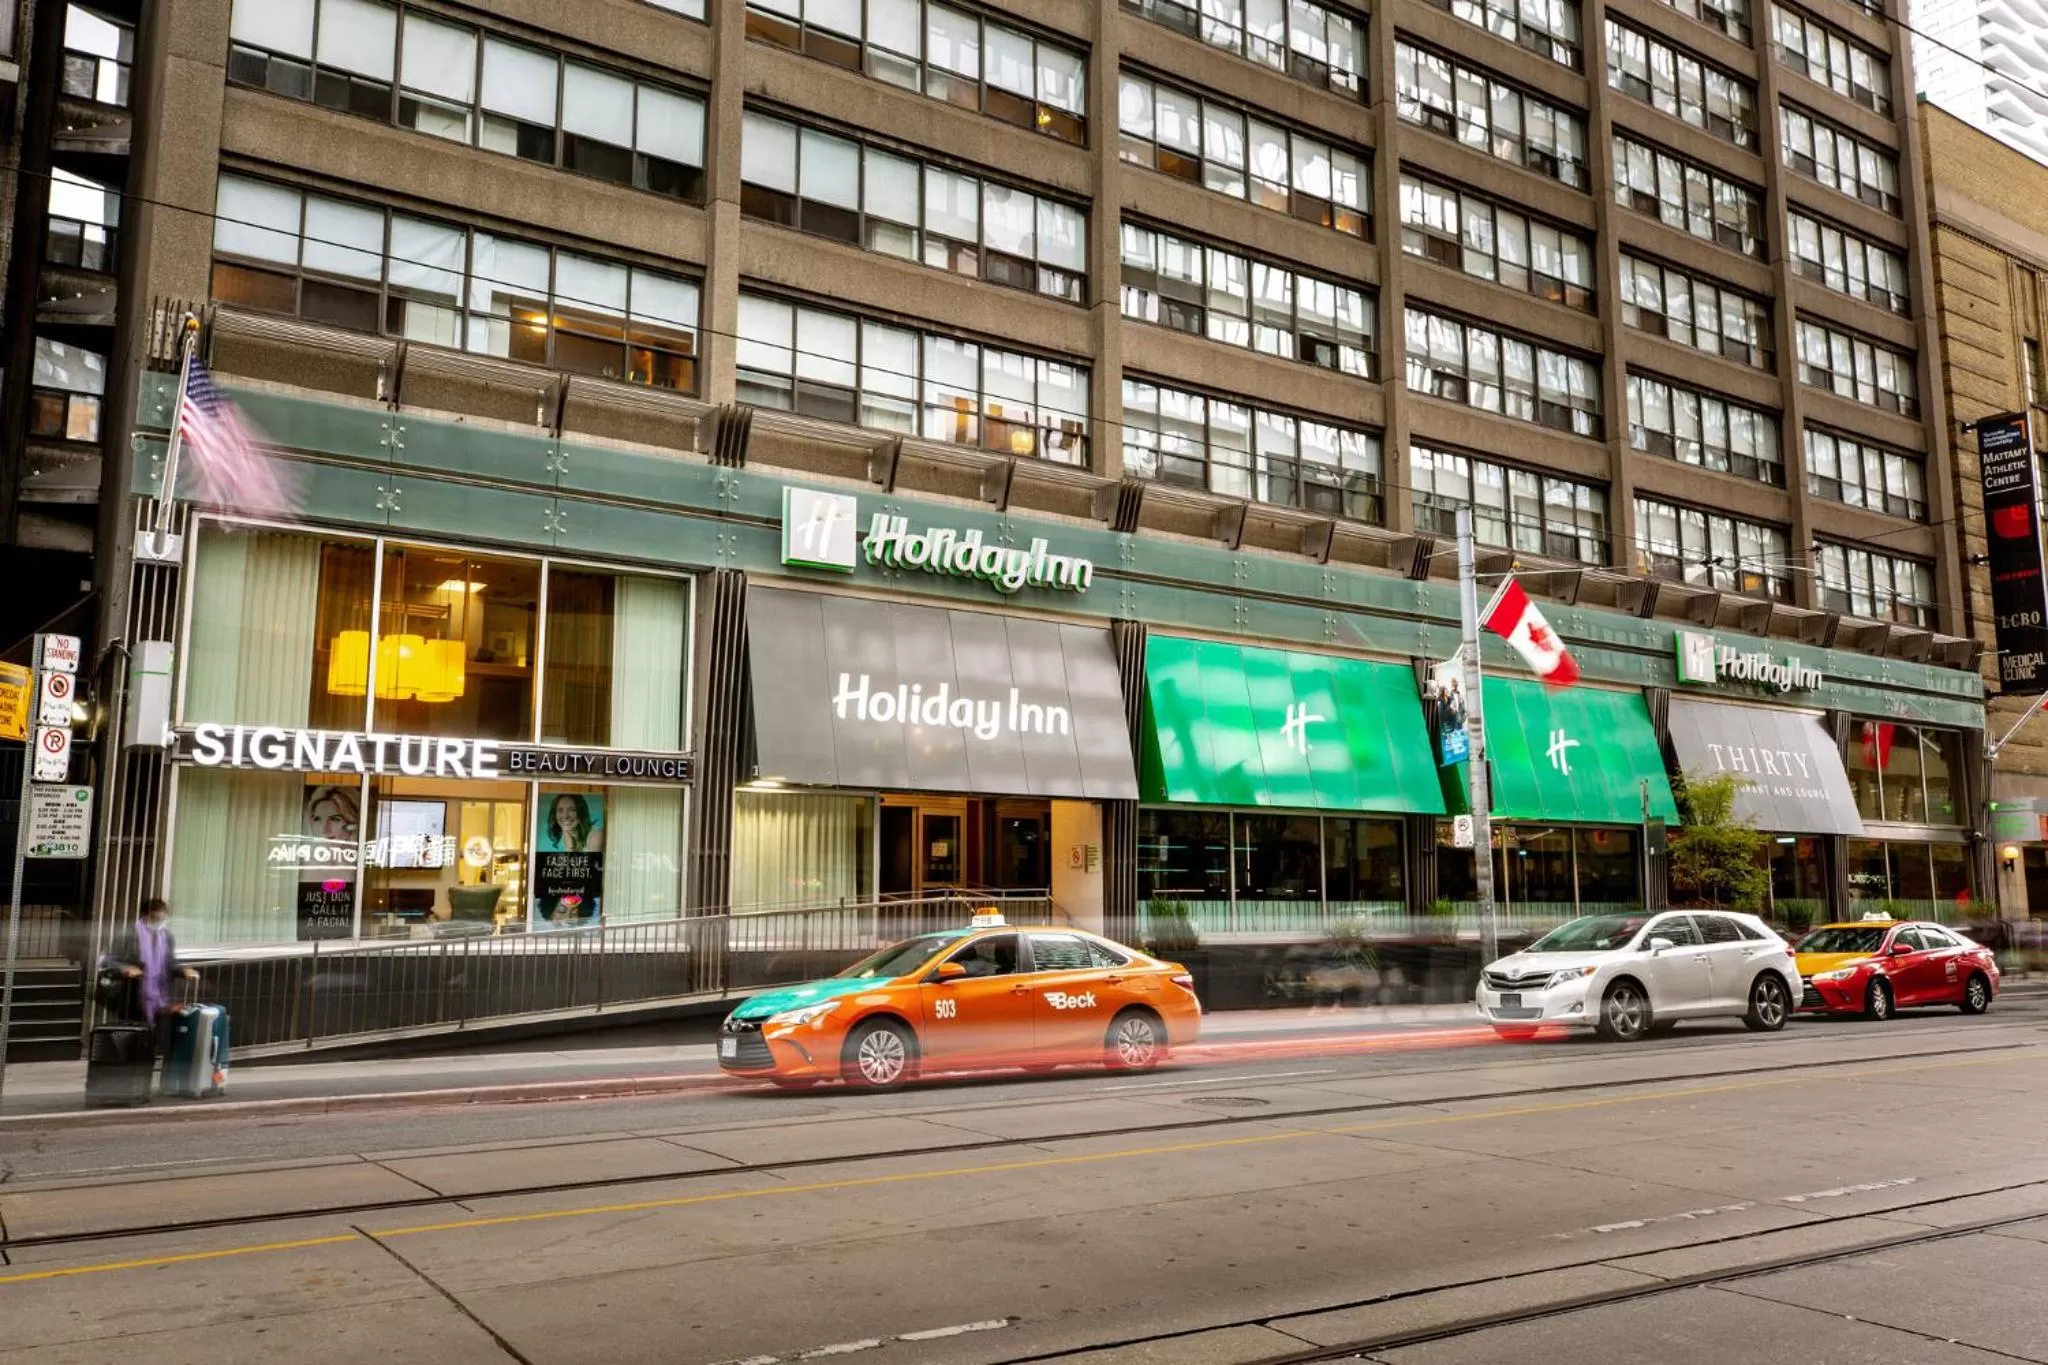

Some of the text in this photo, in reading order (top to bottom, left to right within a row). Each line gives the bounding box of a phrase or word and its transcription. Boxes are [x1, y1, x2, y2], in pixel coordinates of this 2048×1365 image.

[1983, 447, 2027, 464] MATTAMY
[1984, 460, 2027, 476] ATHLETIC
[1985, 474, 2020, 488] CENTRE
[864, 512, 1093, 593] Holiday Inn
[2001, 610, 2041, 629] LCBO
[57, 639, 69, 649] NO
[47, 649, 78, 661] STANDING
[2003, 651, 2046, 668] MEDICAL
[1716, 645, 1823, 692] Holiday Inn
[2004, 666, 2036, 682] CLINIC
[832, 672, 1068, 740] Holiday Inn
[192, 722, 688, 778] SIGNATURE BEAUTY LOUNGE
[1707, 743, 1810, 779] THIRTY
[546, 856, 566, 867] FACE
[542, 867, 563, 878] FACE
[305, 891, 328, 903] JUST
[312, 904, 351, 916] CALL IT
[307, 916, 351, 928] A FACIAL
[1056, 991, 1096, 1009] Beck
[935, 999, 956, 1019] 503
